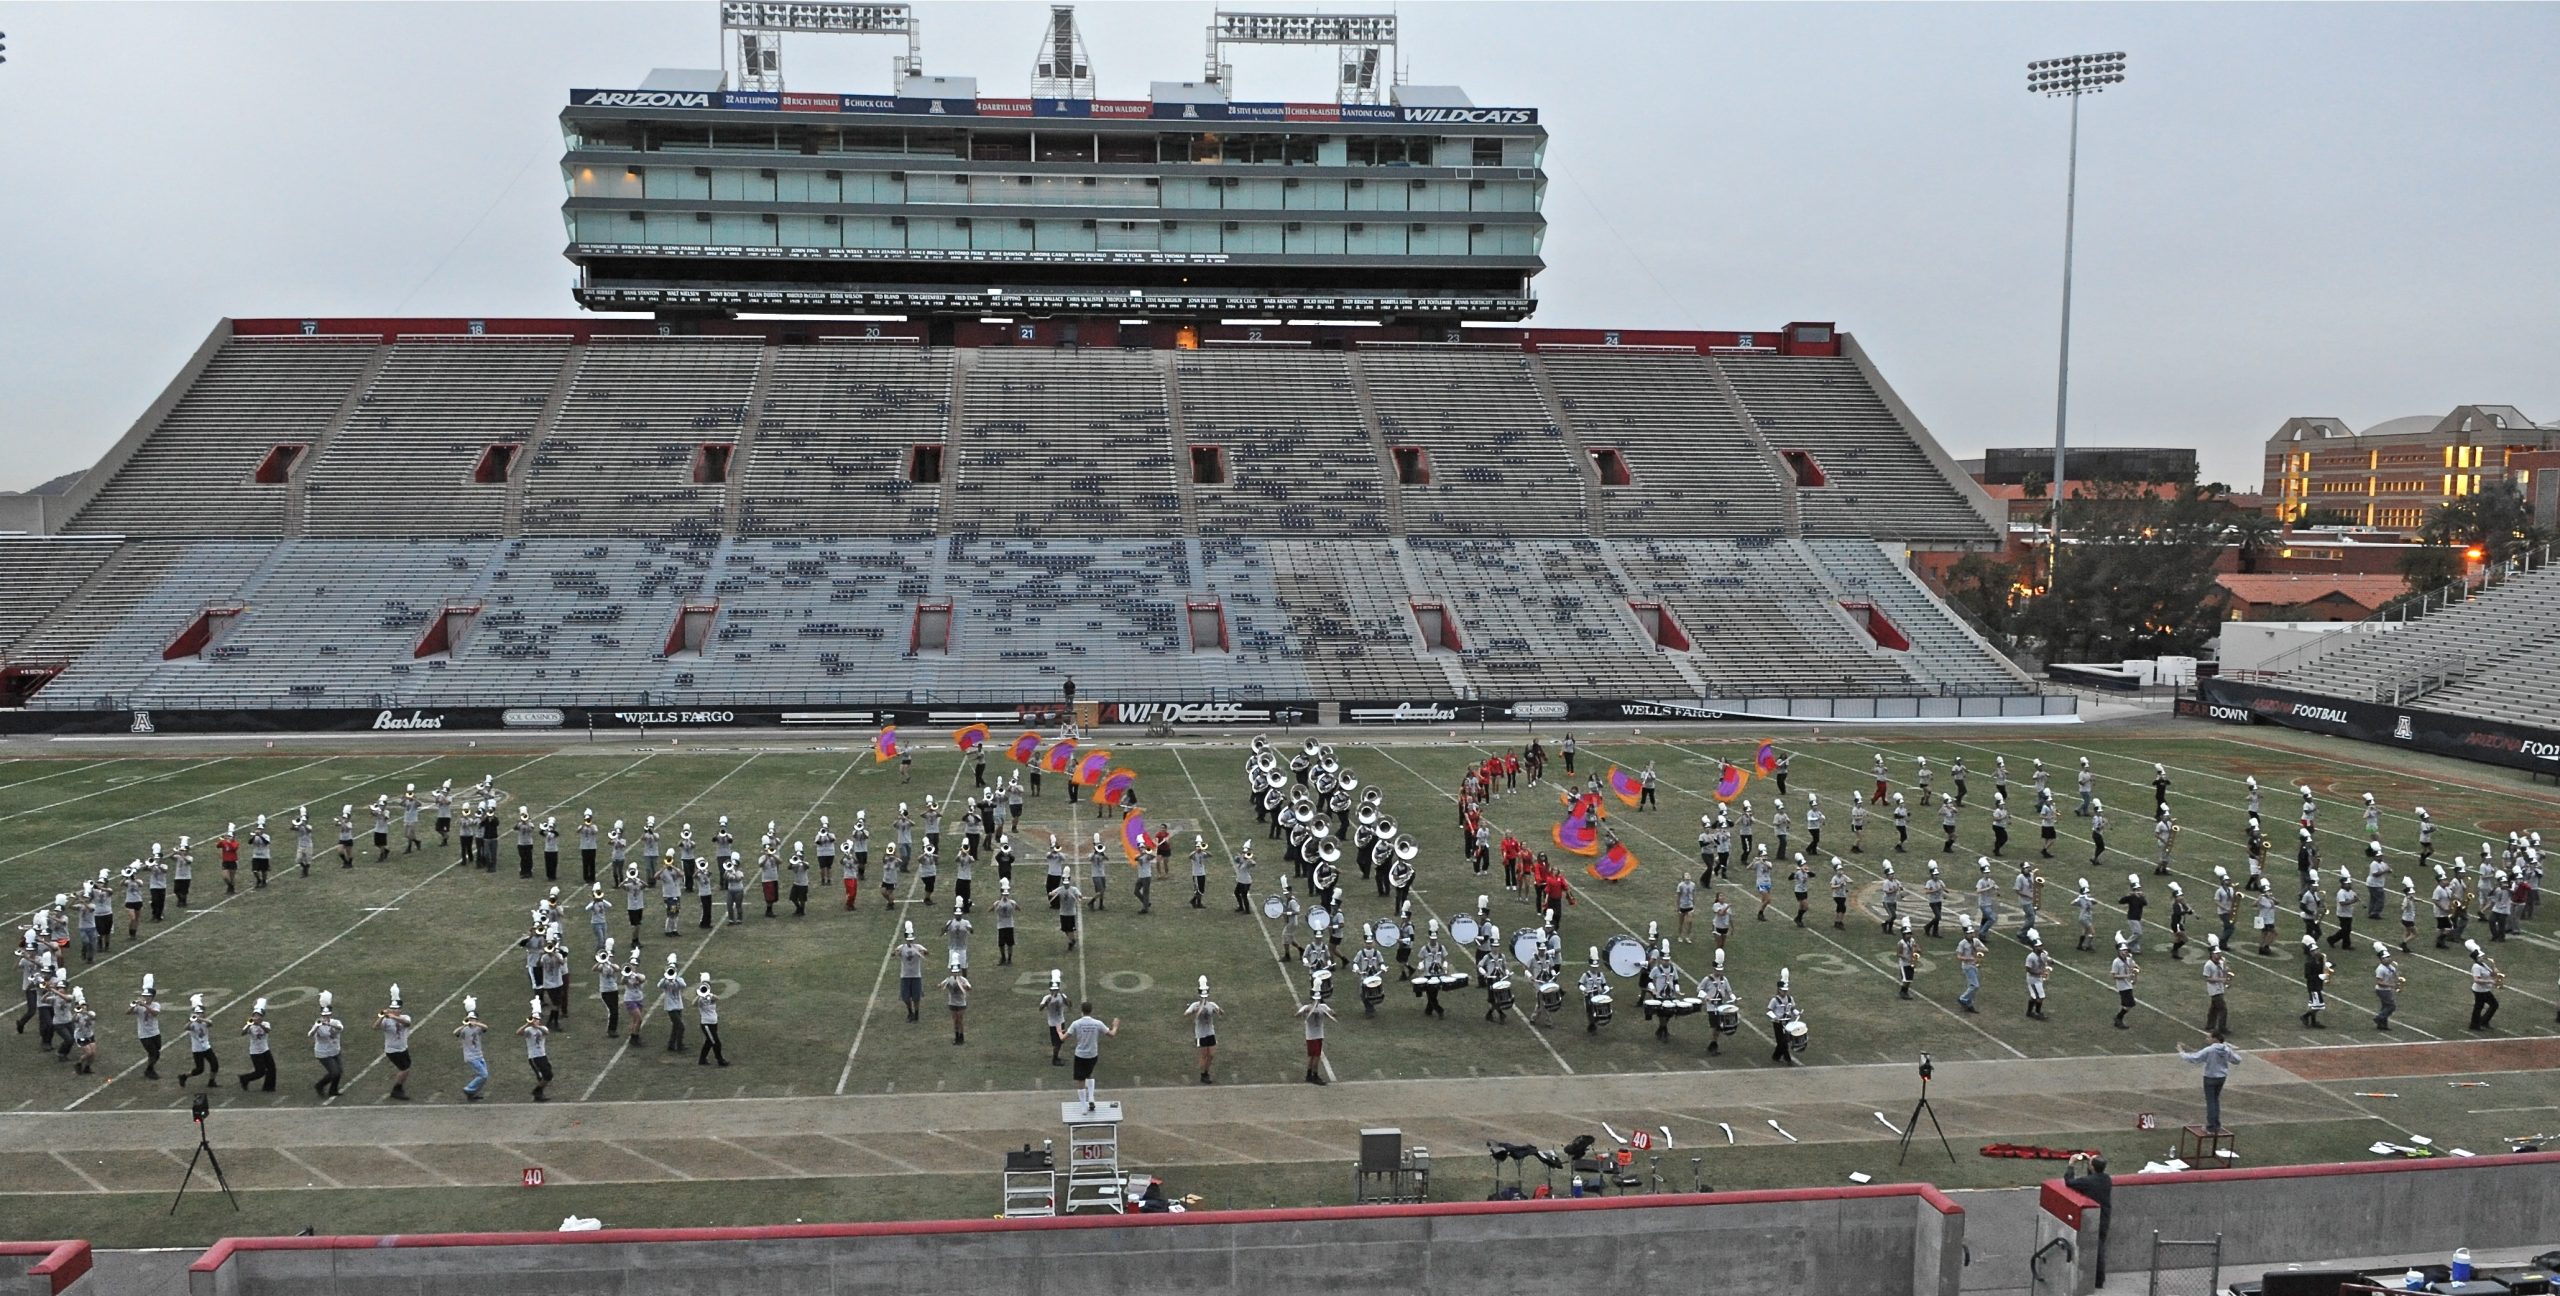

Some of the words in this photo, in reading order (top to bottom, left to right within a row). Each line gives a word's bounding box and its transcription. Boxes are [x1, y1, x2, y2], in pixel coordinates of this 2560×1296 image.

[585, 92, 709, 107] ARIZONA
[726, 95, 734, 103] 22
[735, 96, 747, 104] ART
[749, 96, 778, 105] LUPPINO
[792, 97, 812, 106] RICKY
[813, 98, 839, 107] HUNLEY
[851, 99, 873, 108] CHUCK
[875, 100, 894, 108] CECIL
[982, 103, 1011, 111] DARRYLL
[1237, 107, 1250, 115] STEVE
[1347, 109, 1372, 117] ANTOINE
[1404, 109, 1530, 123] WILDCATS
[303, 325, 315, 335] 17
[471, 325, 483, 335] 18
[658, 327, 670, 335] 19
[866, 328, 880, 337] 20
[1021, 329, 1033, 338] 21
[1249, 332, 1262, 341] 22
[1447, 334, 1459, 343] 23
[1605, 336, 1618, 346] 24
[1739, 337, 1752, 347] 25
[1621, 705, 1671, 716] WELLS
[2209, 705, 2248, 721] DOWN
[2291, 703, 2348, 723] FOOTBALL
[372, 710, 445, 730] Bashas'
[624, 711, 678, 724] WELLS
[681, 711, 734, 723] FARGO
[2141, 1114, 2154, 1129] 30
[1632, 1132, 1646, 1149] 40
[1084, 1145, 1101, 1159] 50
[525, 1169, 541, 1185] 40
